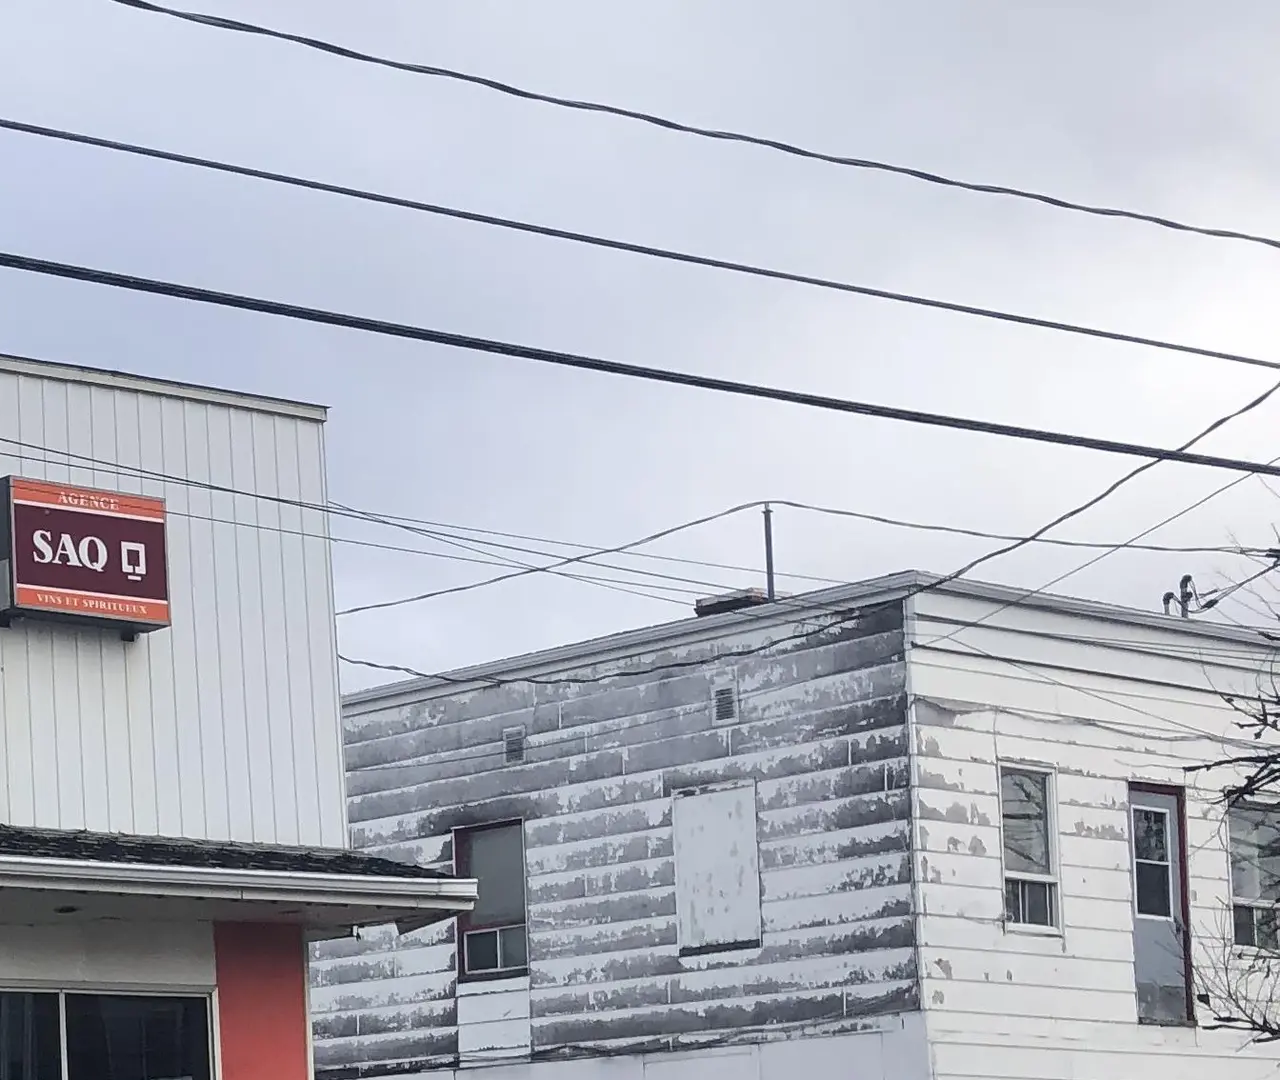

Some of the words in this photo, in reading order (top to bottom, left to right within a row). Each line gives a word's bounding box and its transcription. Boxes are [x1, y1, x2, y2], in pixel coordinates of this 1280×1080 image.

[57, 491, 120, 511] AGENCE
[32, 529, 108, 572] SAQ
[37, 593, 62, 605] VINS
[65, 597, 79, 607] ET
[83, 599, 148, 614] SPIRITUEUX
